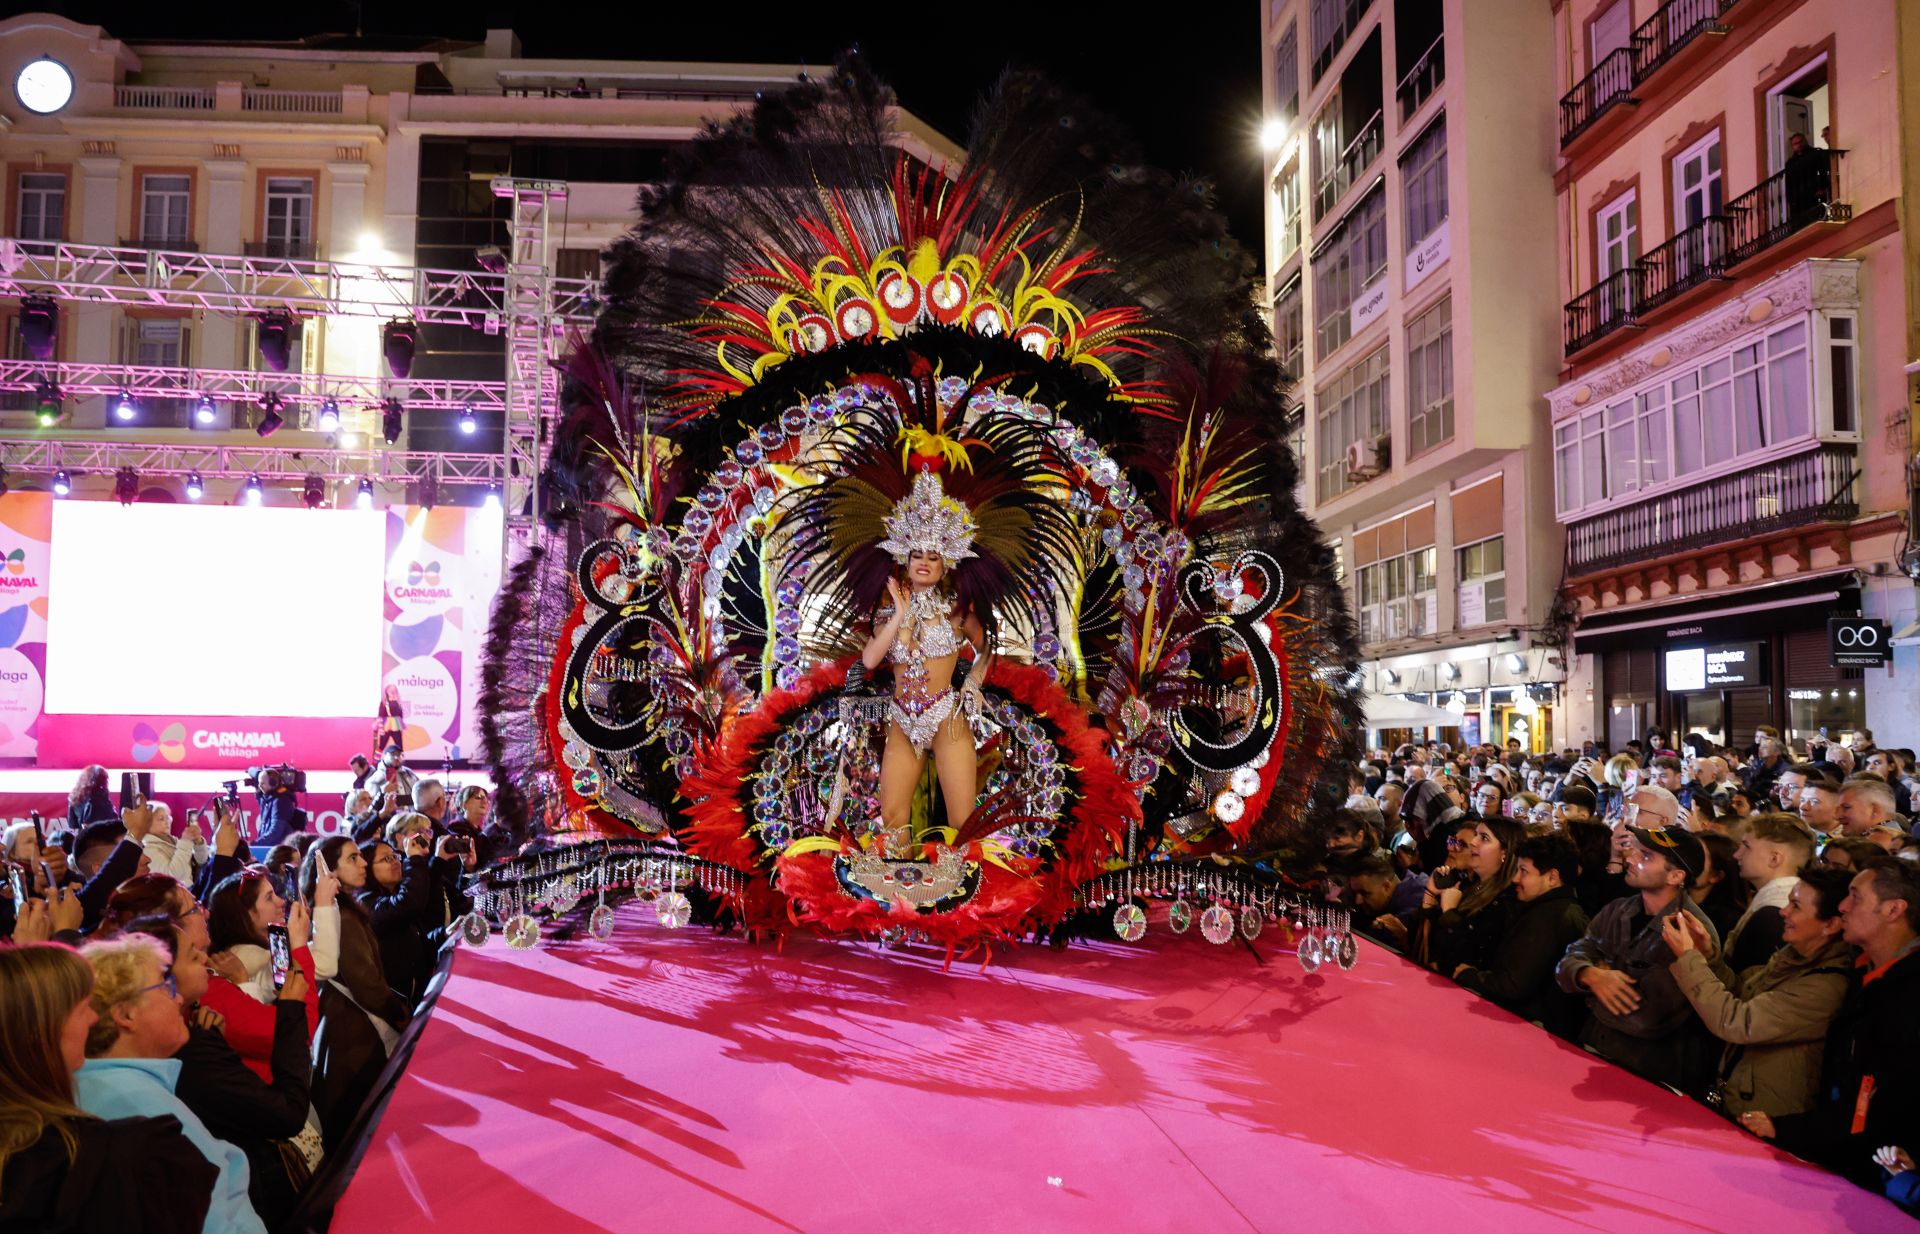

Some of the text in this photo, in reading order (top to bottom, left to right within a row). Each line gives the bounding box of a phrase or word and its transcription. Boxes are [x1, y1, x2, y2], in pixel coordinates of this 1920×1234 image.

[394, 586, 453, 598] CARNAVAL
[1689, 626, 1703, 634] BACA
[1707, 663, 1728, 675] BACA
[192, 729, 286, 749] CARNAVAL
[218, 747, 259, 759] Málaga
